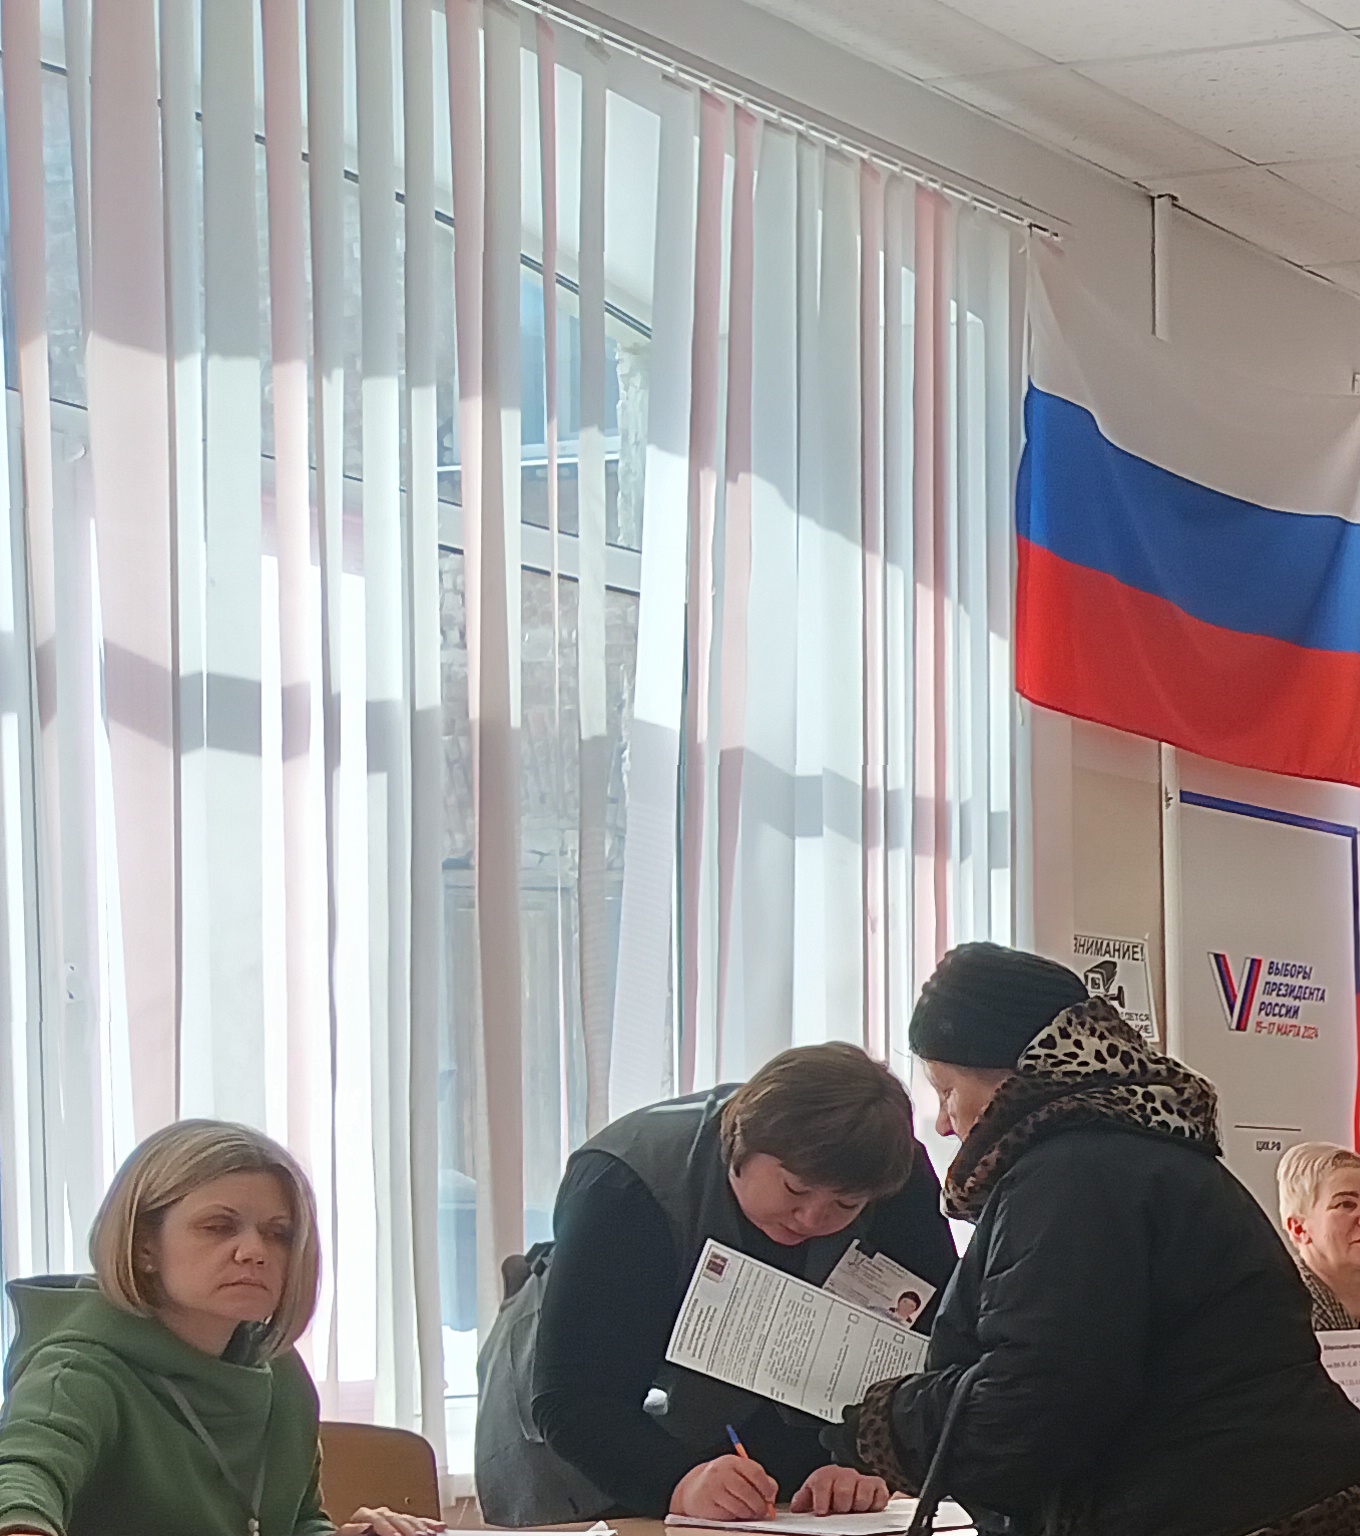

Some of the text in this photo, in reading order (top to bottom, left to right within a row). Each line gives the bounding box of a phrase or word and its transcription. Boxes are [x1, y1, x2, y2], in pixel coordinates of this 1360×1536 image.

[1267, 961, 1313, 980] ВЫБОРЫ
[1262, 981, 1326, 1003] ПРЕЗИДЕНТА
[1257, 1001, 1300, 1020] РОССИИ
